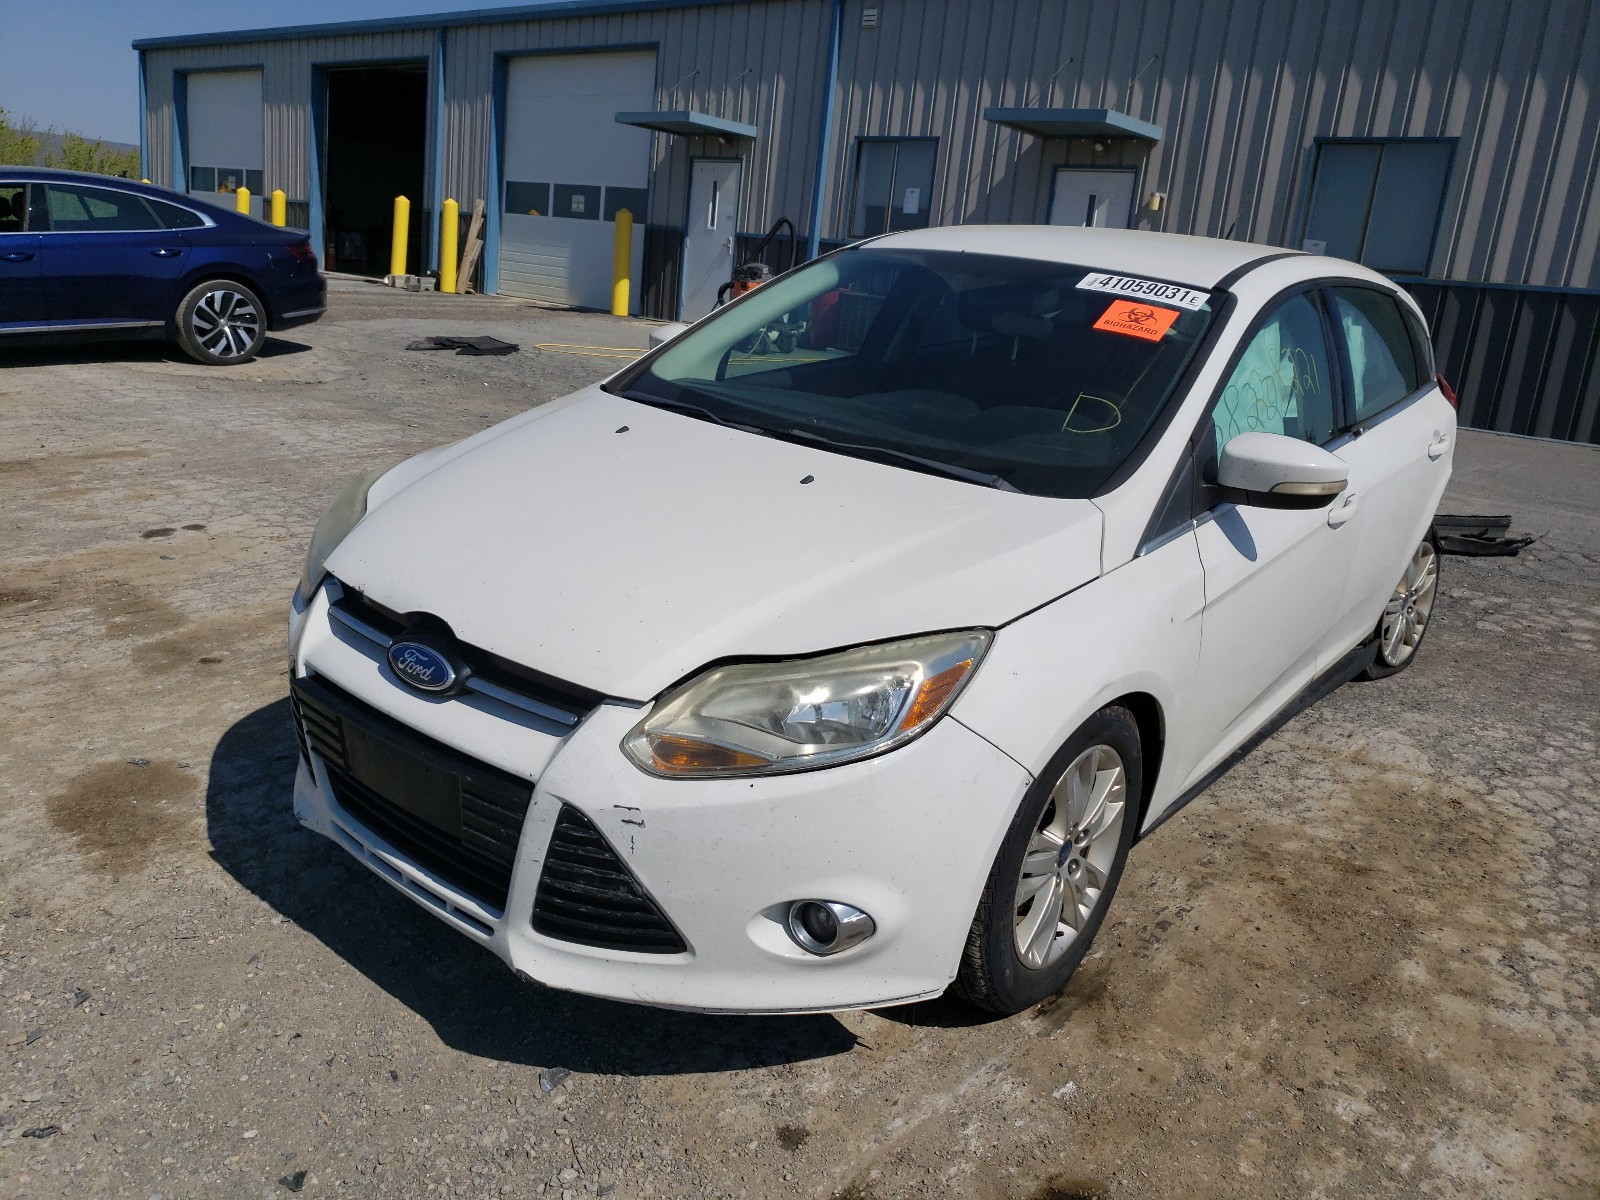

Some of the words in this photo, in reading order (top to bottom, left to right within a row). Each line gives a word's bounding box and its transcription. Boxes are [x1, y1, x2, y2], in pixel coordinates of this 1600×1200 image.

[1099, 276, 1191, 302] 41059031
[1103, 319, 1158, 335] BIOHAZARD
[1062, 391, 1122, 433] D
[398, 649, 436, 681] Ford
